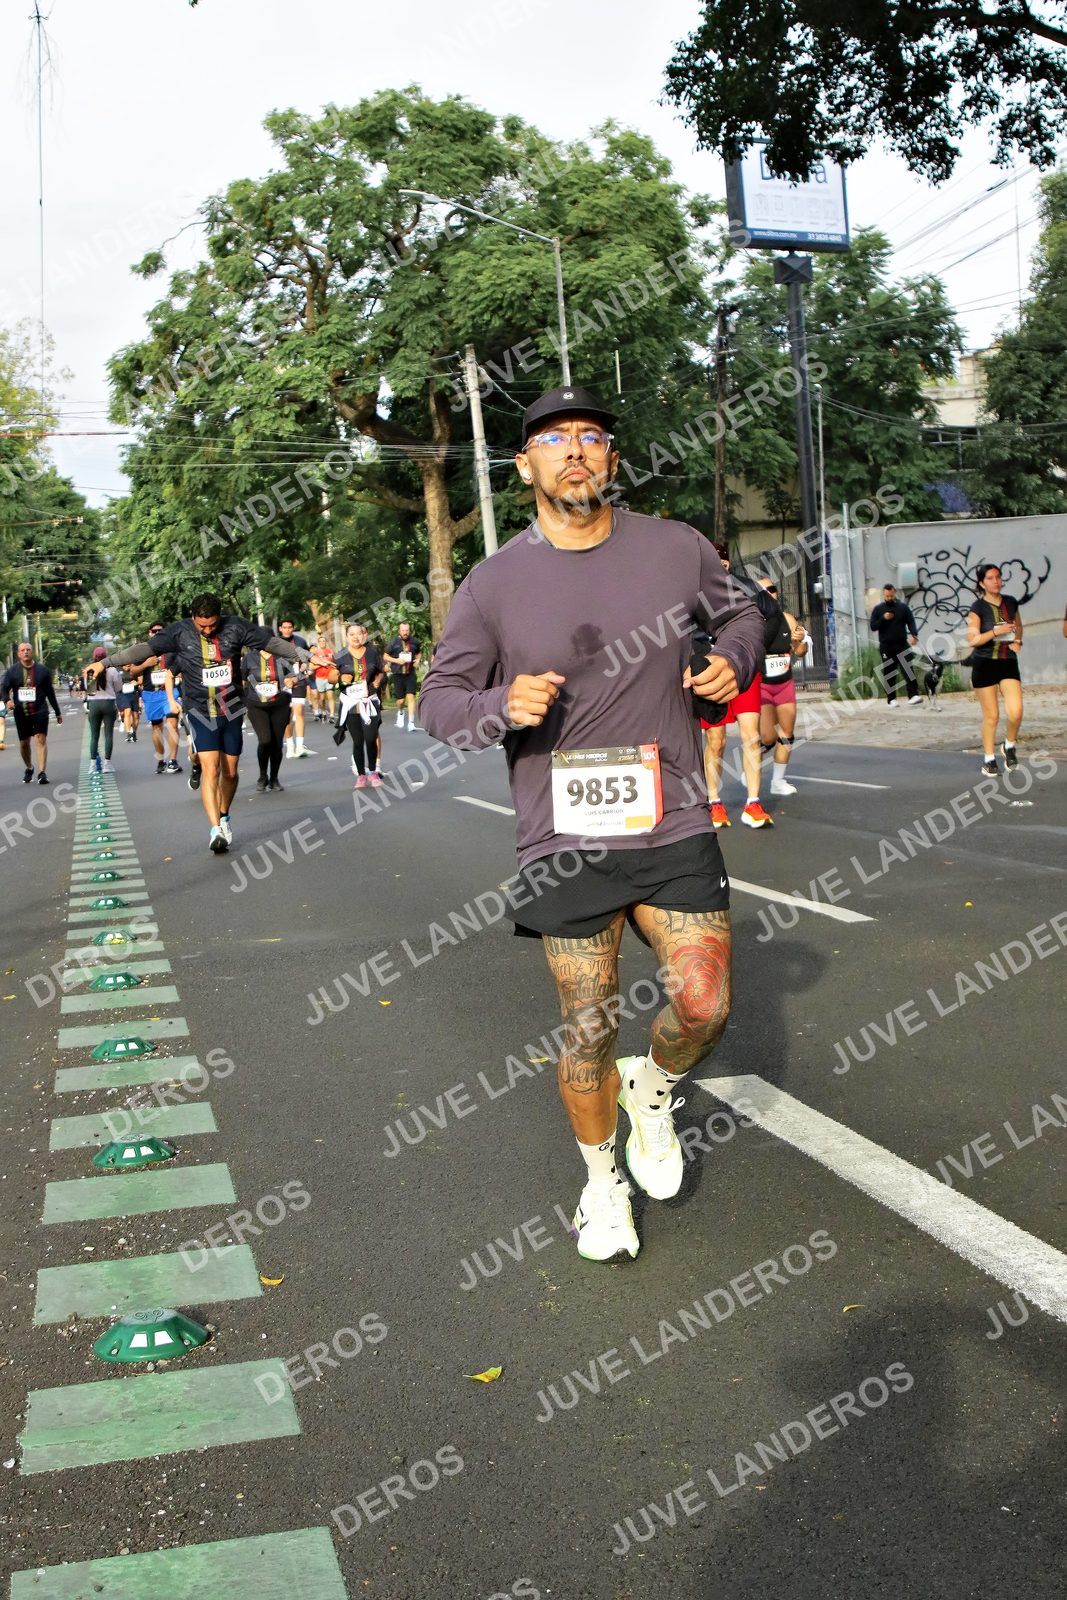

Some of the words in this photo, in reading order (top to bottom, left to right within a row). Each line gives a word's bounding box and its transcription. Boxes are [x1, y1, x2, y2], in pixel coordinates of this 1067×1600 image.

[918, 545, 972, 566] TOY
[205, 668, 229, 679] 10505
[642, 751, 656, 760] 10K
[566, 775, 638, 807] 9853
